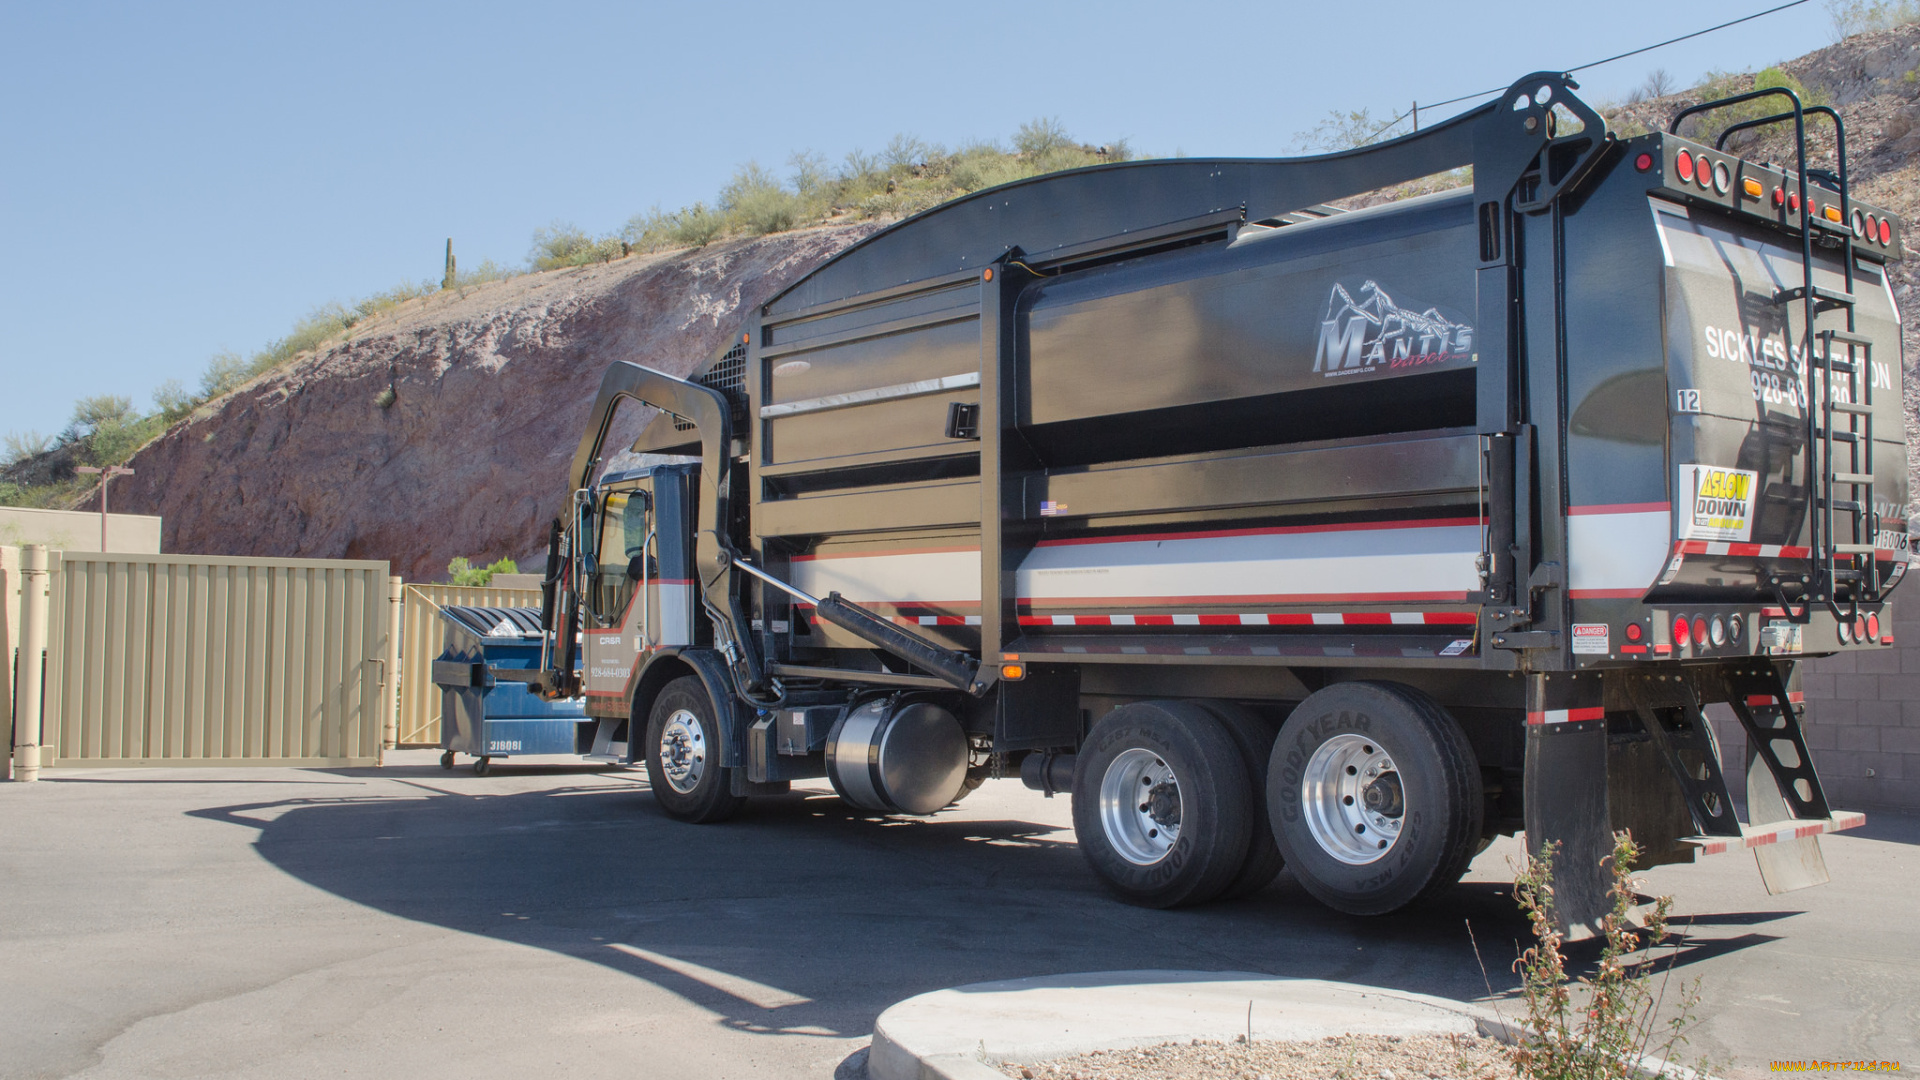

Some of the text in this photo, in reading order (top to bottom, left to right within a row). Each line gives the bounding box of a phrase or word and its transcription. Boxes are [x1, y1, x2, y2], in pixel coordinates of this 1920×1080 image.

[1313, 316, 1473, 373] MANTIS
[1705, 325, 1787, 371] SICKLES
[1679, 391, 1699, 410] 12
[1711, 471, 1751, 501] SLOW
[1697, 500, 1746, 517] DOWN
[1708, 517, 1744, 529] AROUND
[1581, 627, 1605, 635] DANGER
[490, 740, 522, 751] 318081
